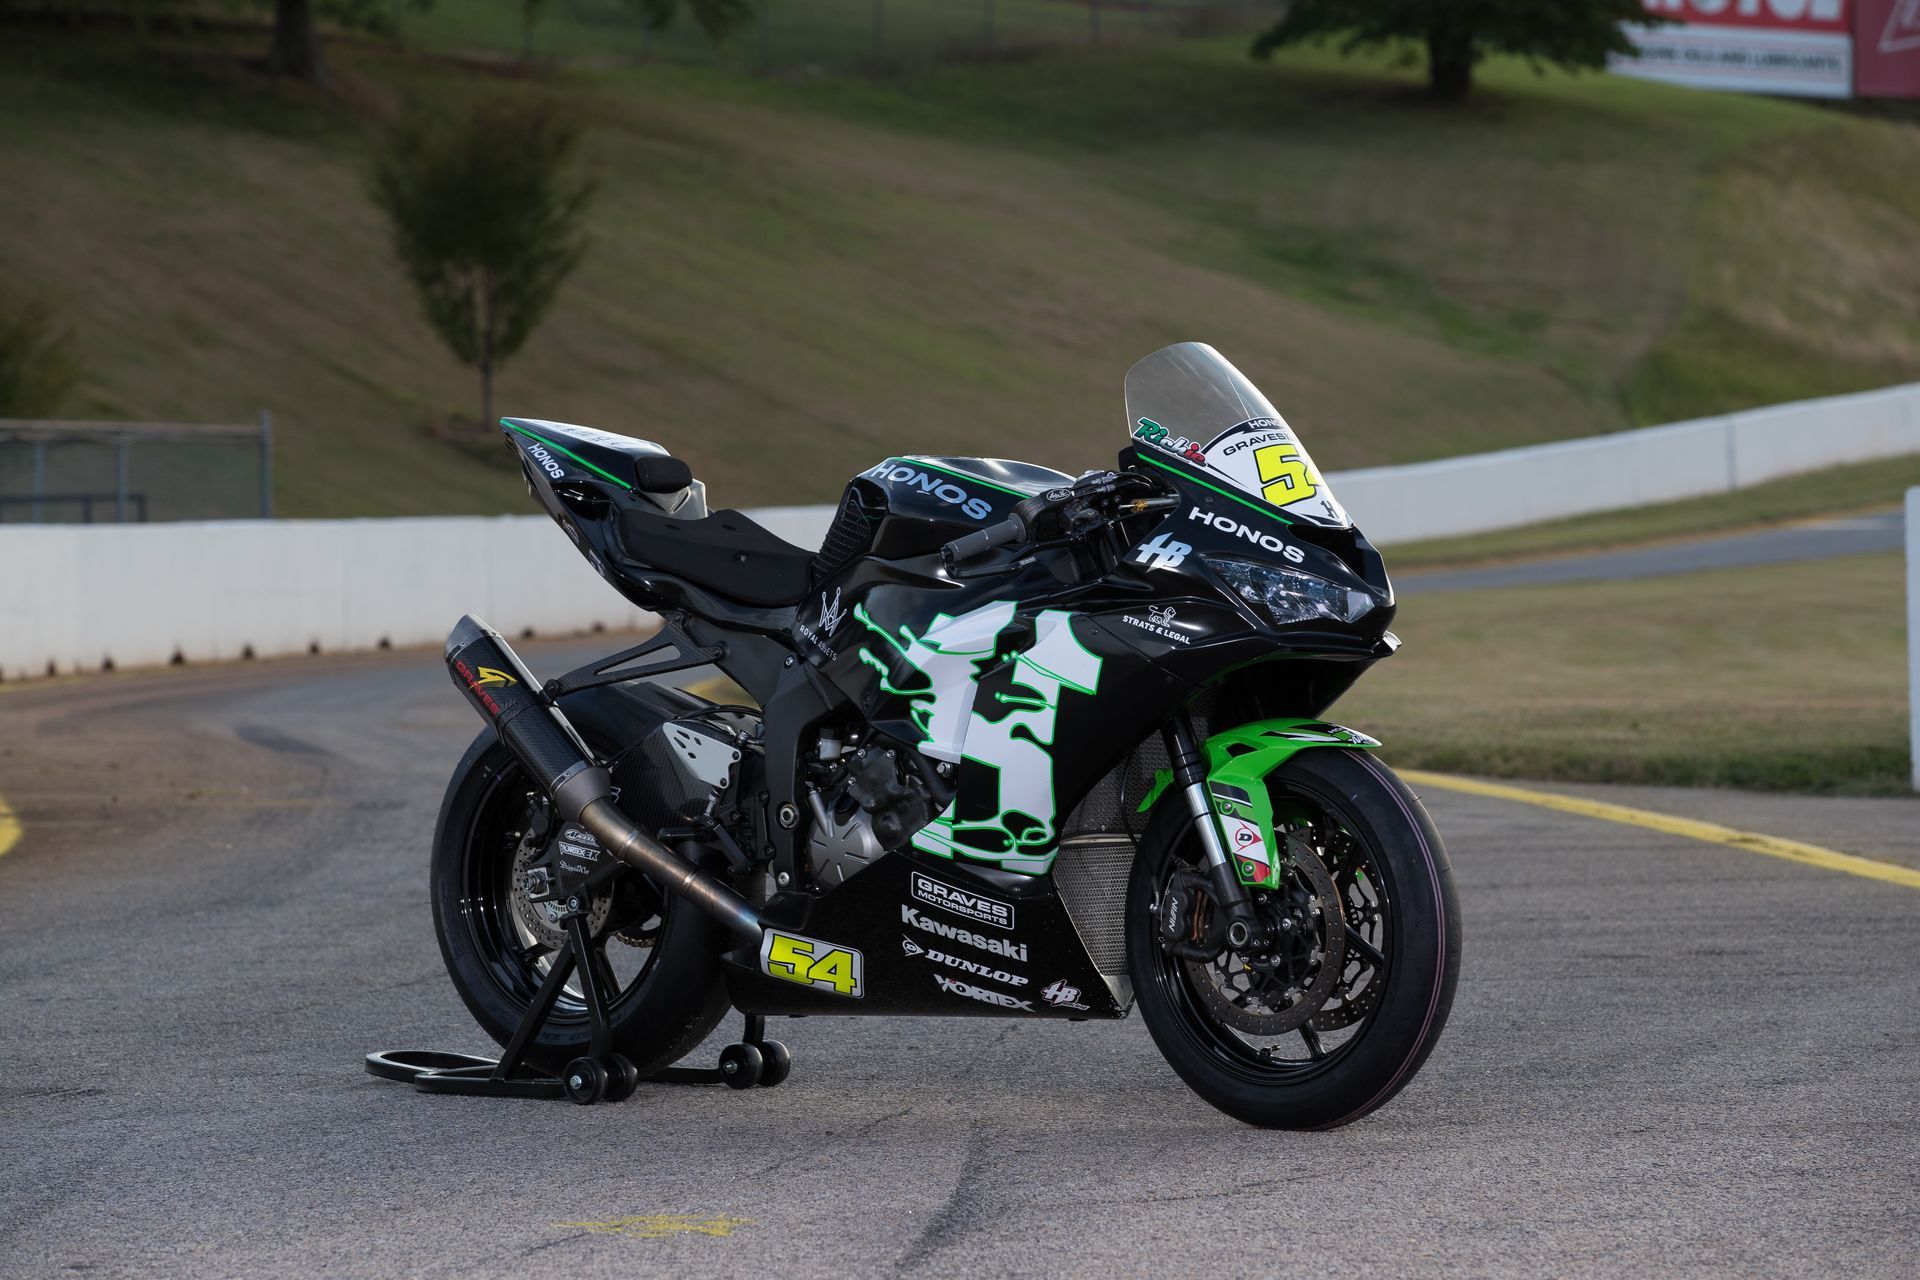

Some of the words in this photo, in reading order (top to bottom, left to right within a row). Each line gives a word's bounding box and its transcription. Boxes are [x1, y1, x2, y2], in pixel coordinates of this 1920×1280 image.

[528, 443, 565, 479] HONOS
[1222, 432, 1287, 457] GRAVES
[871, 463, 993, 520] HONOS
[1188, 506, 1306, 564] HONOS
[799, 624, 818, 645] ROYAL
[1122, 614, 1156, 632] STRATS
[1155, 626, 1164, 635] &
[1163, 629, 1191, 645] LEGAL
[917, 878, 1008, 918] GRAVES
[917, 889, 1008, 926] MOTORSPORTS
[901, 904, 1028, 963] Kawasaki
[768, 932, 858, 994] 54
[925, 948, 1029, 987] DUNLOP
[932, 973, 1037, 1013] VORTEX
